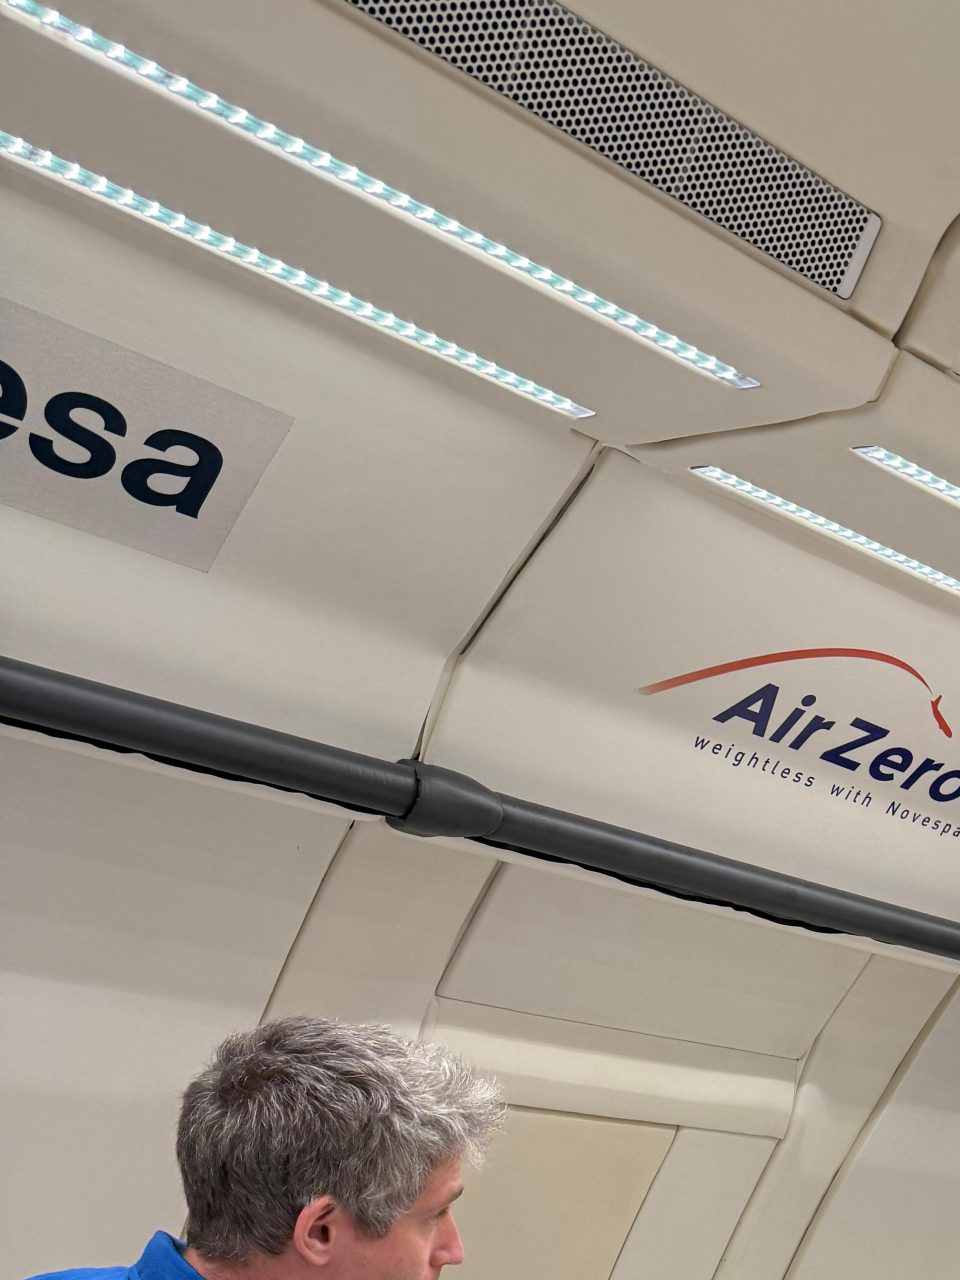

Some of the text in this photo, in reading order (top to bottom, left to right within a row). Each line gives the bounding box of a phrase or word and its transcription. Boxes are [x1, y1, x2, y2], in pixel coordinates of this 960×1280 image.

[0, 359, 224, 519] sa
[694, 735, 816, 788] weightless
[829, 782, 873, 808] with
